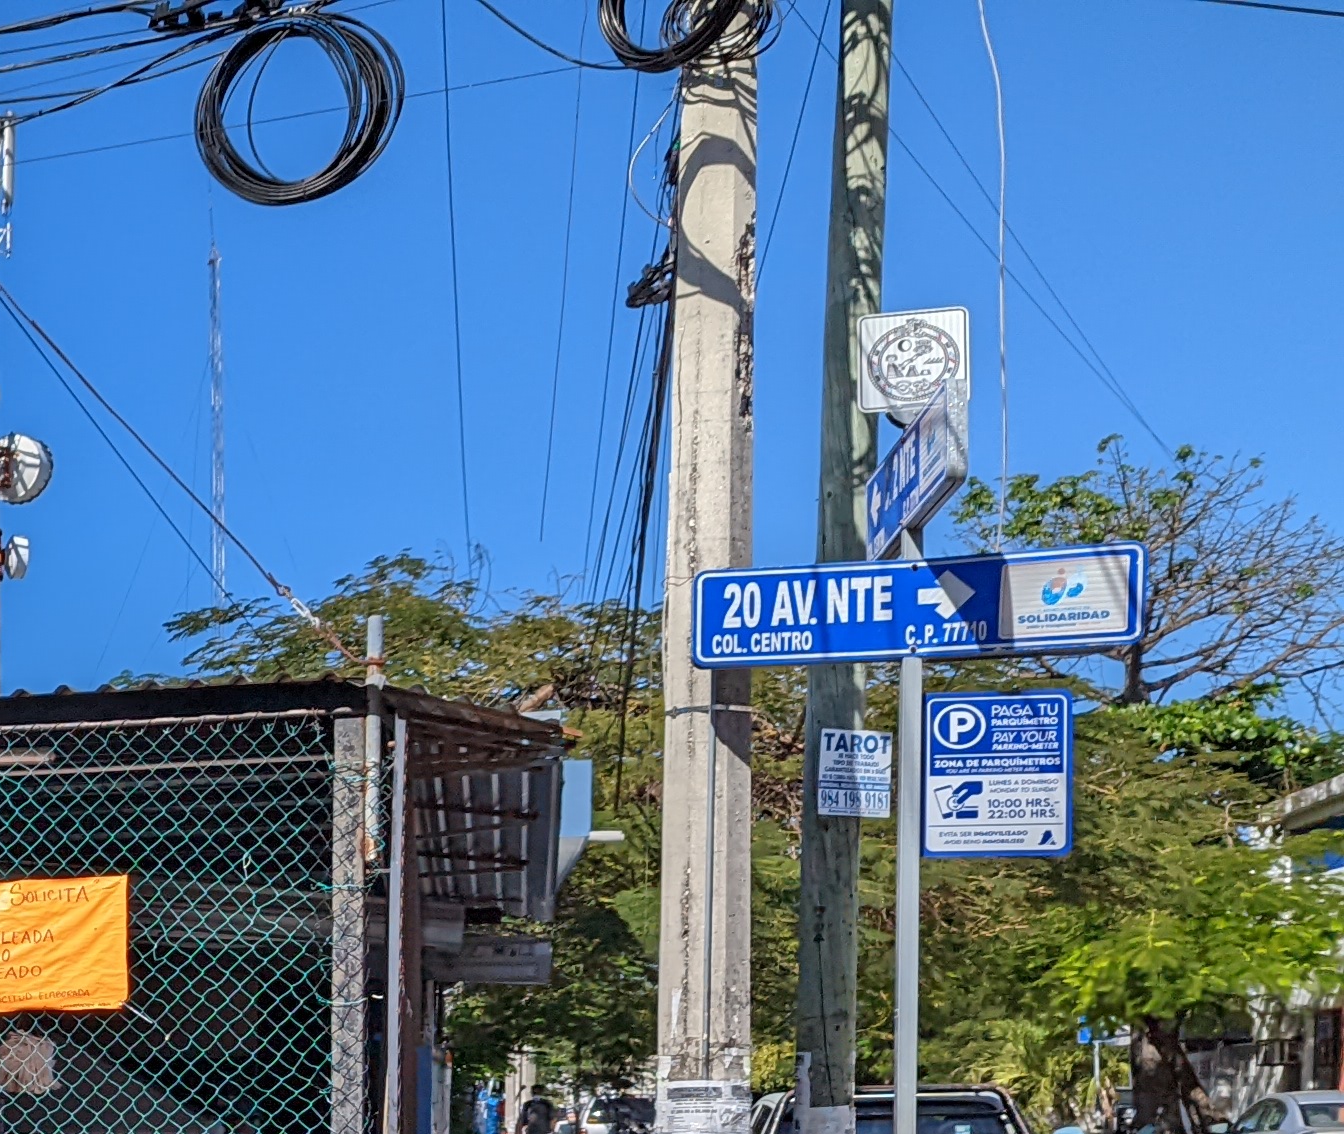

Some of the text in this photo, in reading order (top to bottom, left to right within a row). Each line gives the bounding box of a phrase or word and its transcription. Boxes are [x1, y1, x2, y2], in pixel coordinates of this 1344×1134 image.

[723, 575, 894, 629] 20 AV. NTE
[1017, 610, 1111, 625] SOLIDARIDAD
[941, 620, 988, 643] 77710
[712, 631, 812, 654] COL. CENTRO
[991, 703, 1058, 717] PAGA TU
[949, 711, 976, 743] P
[991, 715, 1059, 727] PARQUÍMETRO
[824, 733, 891, 754] TAROT
[992, 730, 1057, 743] PAY YOUR
[992, 741, 1059, 751] PARKING-METER
[934, 756, 1061, 768] ZONA DE PARQUÍMETROS
[820, 789, 889, 809] 984 198 9181
[987, 798, 1022, 808] 10:00
[987, 808, 1060, 819] 22:00 HRS.
[39, 988, 90, 1000] ELABORADA
